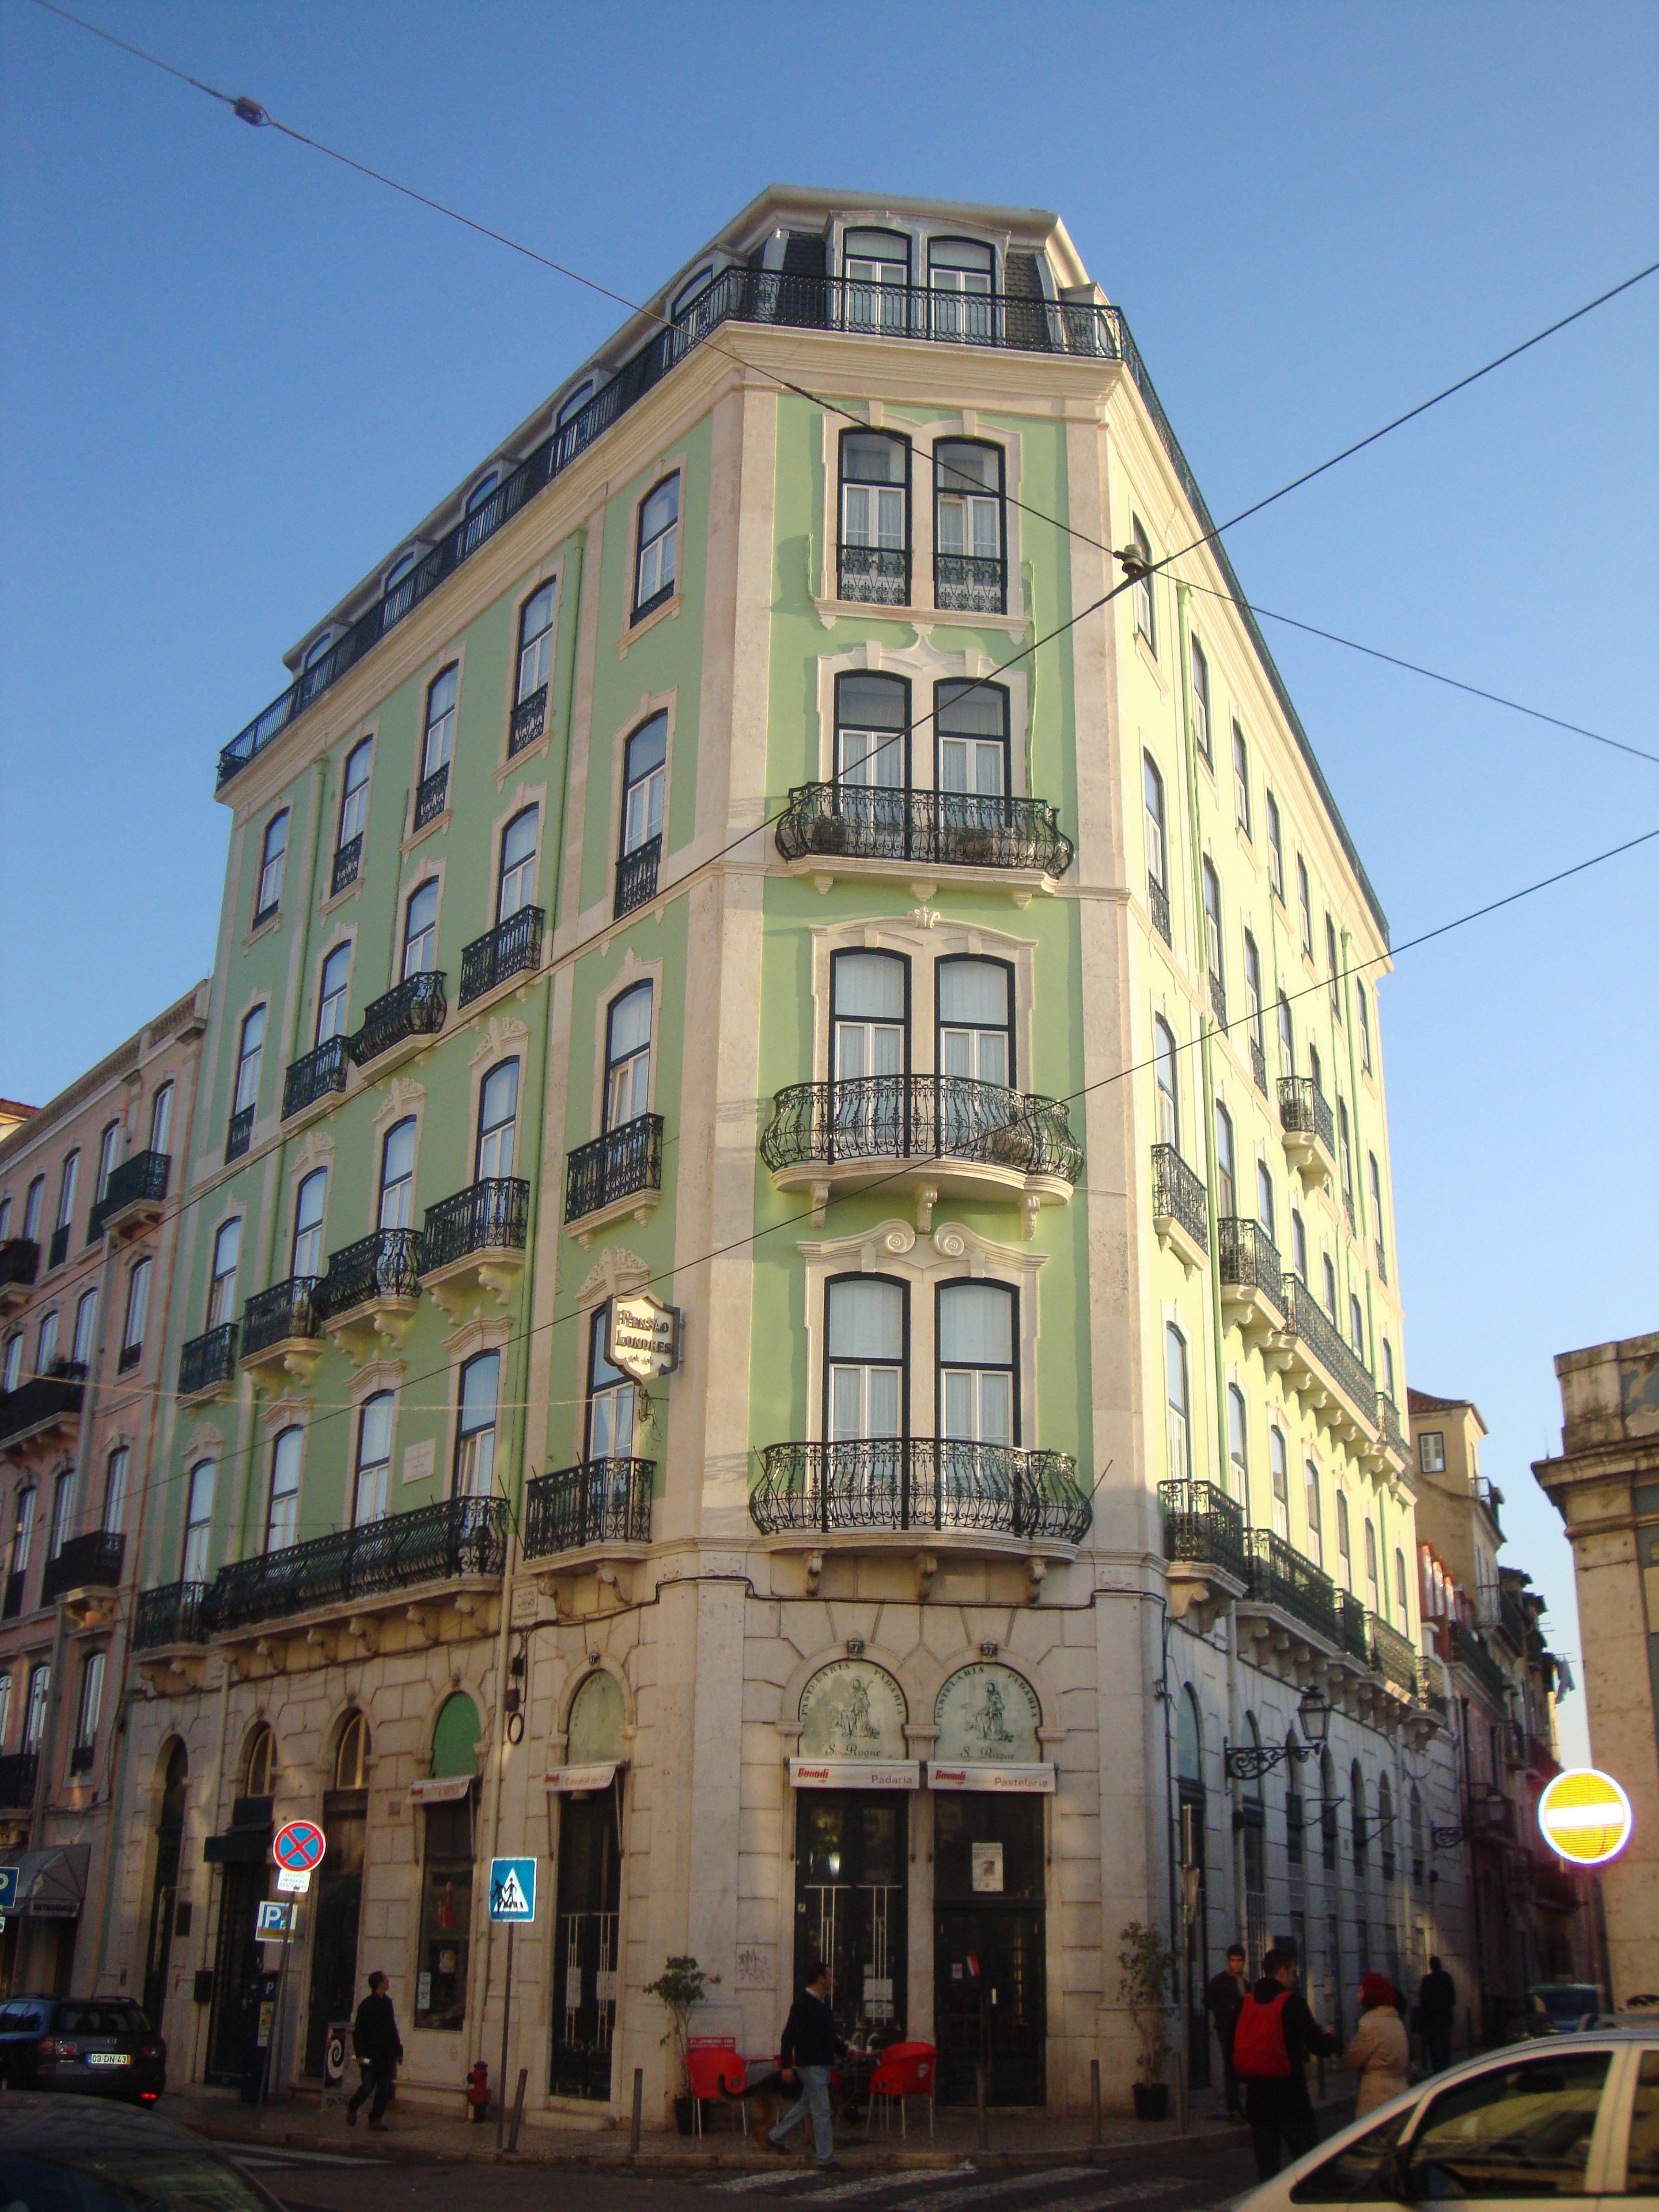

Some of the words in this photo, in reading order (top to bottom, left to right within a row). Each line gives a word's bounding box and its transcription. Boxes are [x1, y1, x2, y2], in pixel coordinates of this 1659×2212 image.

[616, 1330, 672, 1354] LONDRES
[801, 1664, 850, 1715] PASTELARIA
[874, 1669, 904, 1715] PADARIA
[936, 1666, 984, 1718] PASTELARIA
[1007, 1673, 1037, 1717] PADARIA
[844, 1744, 881, 1759] Roque
[980, 1747, 1015, 1760] Roque
[871, 1775, 912, 1784] Padaria
[994, 1777, 1048, 1787] Pastelaria
[264, 1906, 281, 1927] P
